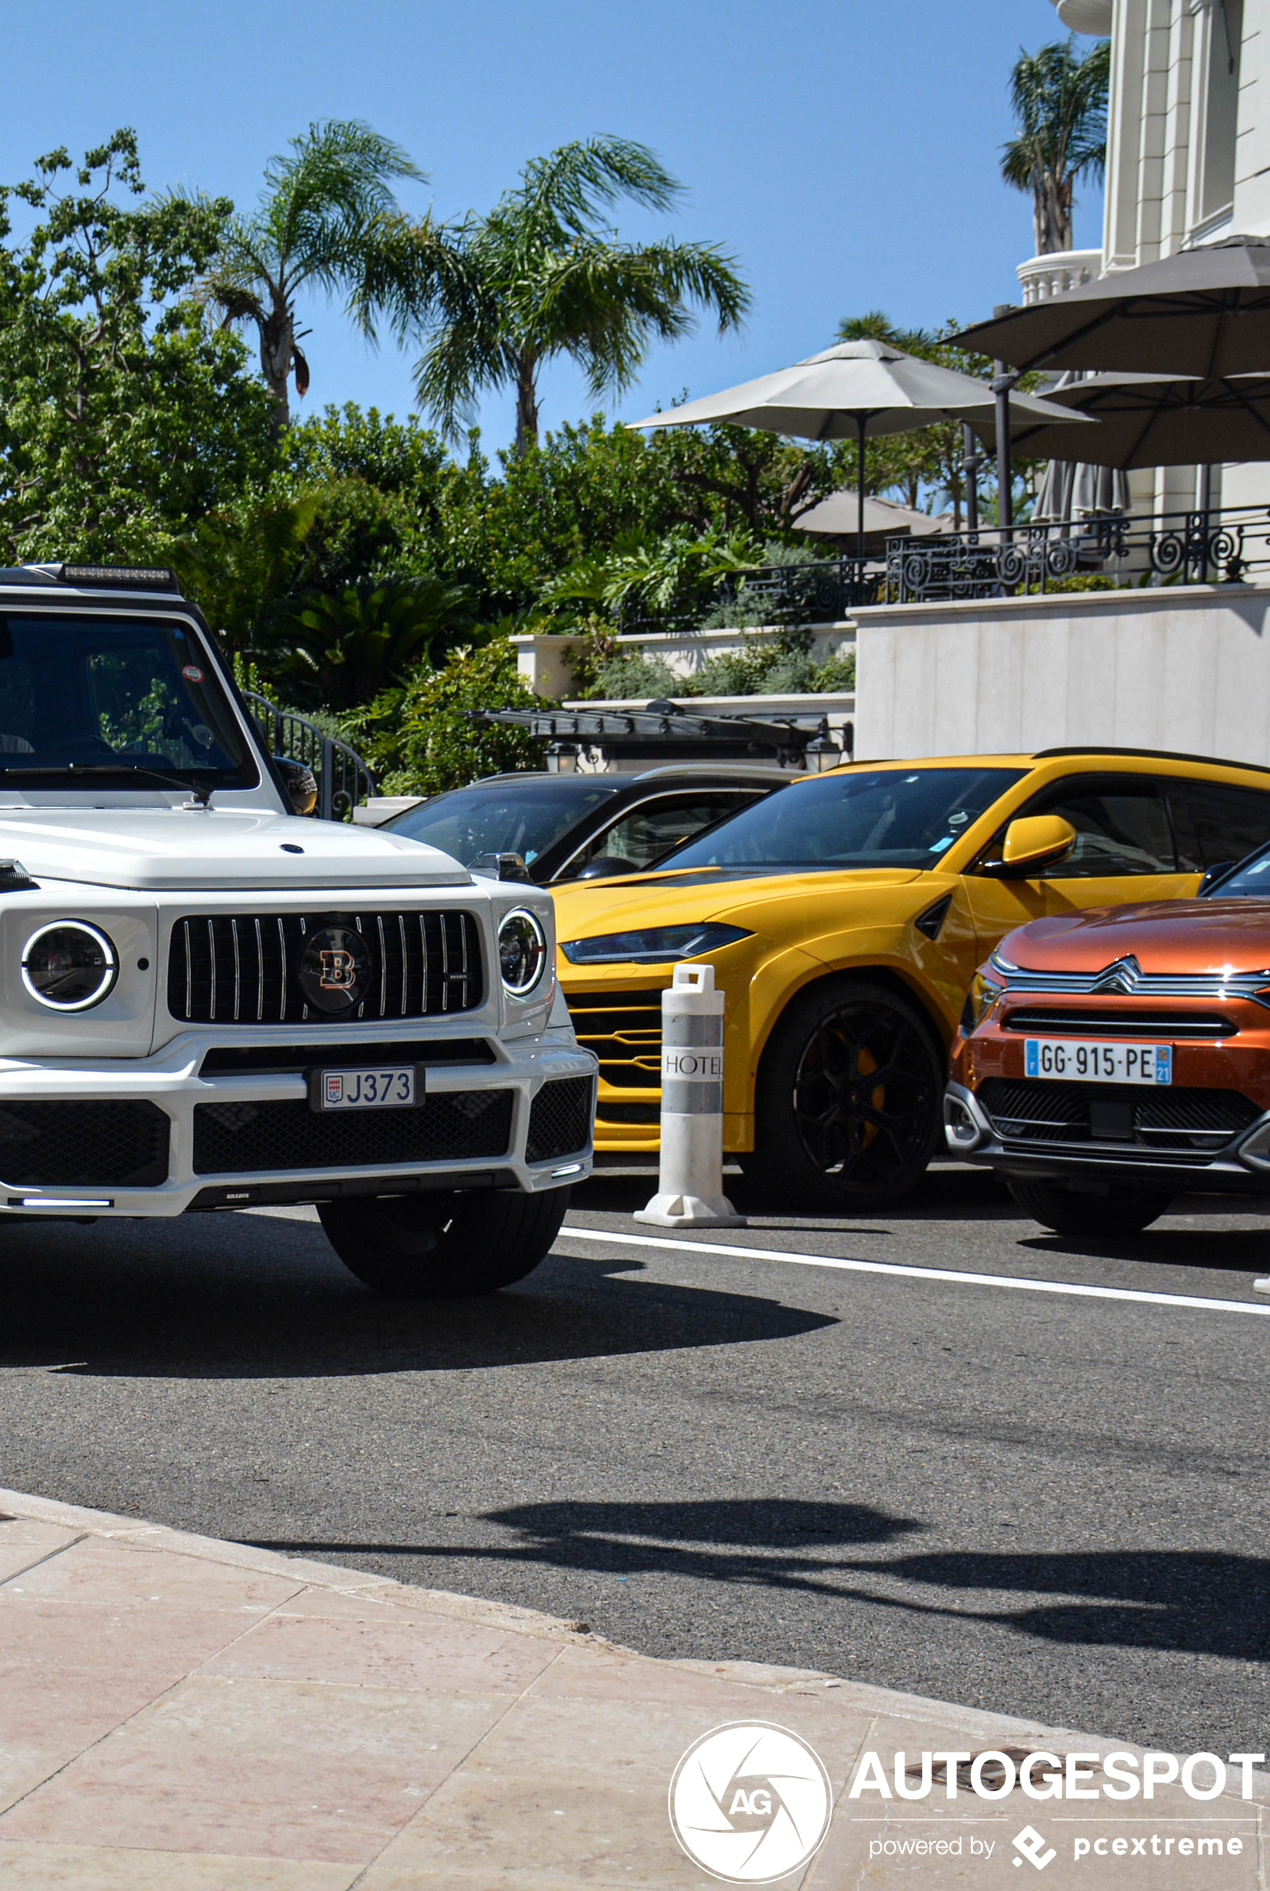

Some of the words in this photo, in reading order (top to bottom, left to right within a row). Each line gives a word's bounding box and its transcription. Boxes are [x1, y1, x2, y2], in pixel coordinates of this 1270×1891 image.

[666, 1055, 724, 1075] HOTEL
[1041, 1044, 1153, 1078] GG-915-PE
[1157, 1067, 1169, 1081] 21
[347, 1073, 410, 1103] J373
